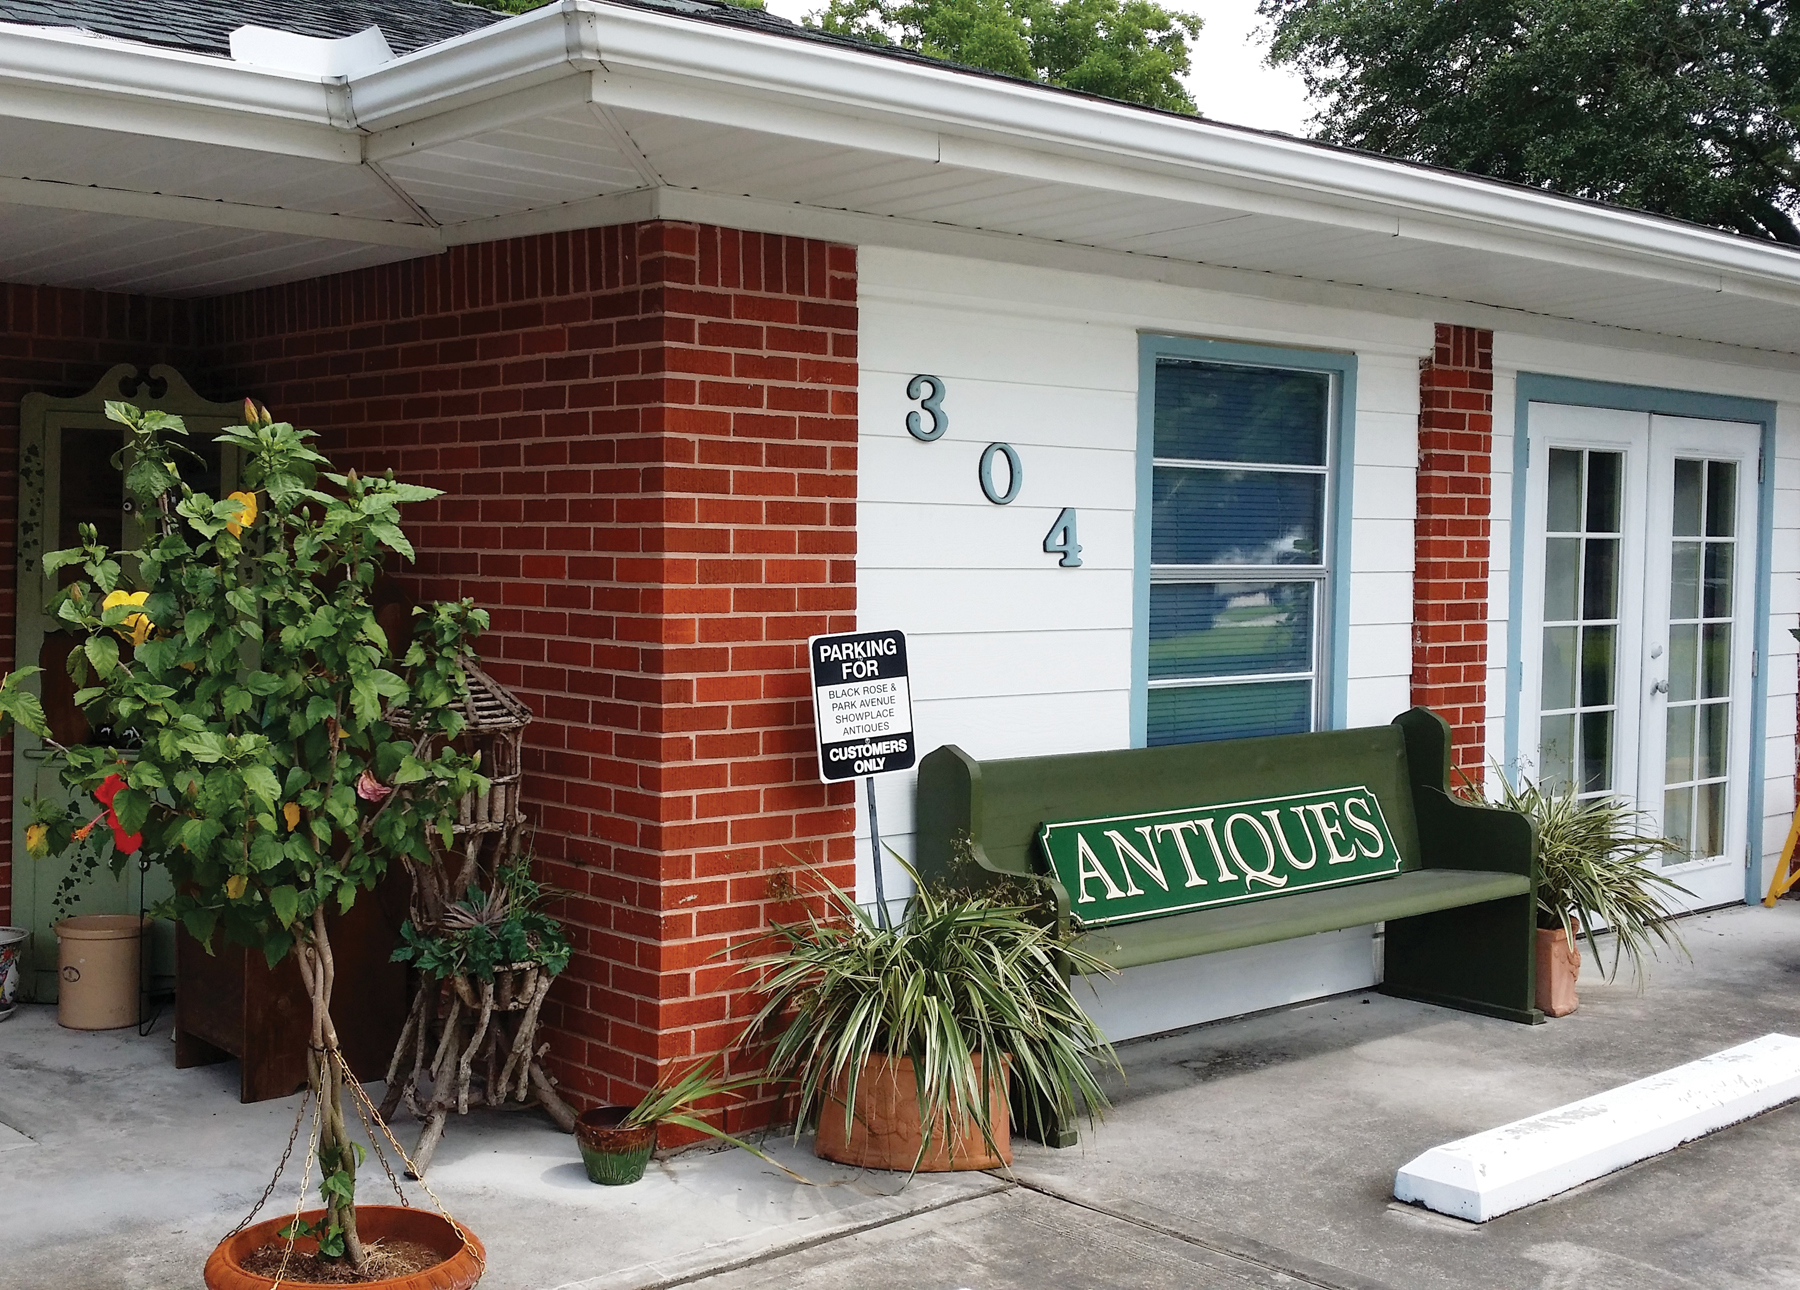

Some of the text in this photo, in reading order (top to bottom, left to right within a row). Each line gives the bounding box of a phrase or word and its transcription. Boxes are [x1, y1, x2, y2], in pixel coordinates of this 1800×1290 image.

[820, 638, 897, 662] PARKING
[842, 660, 879, 679] FOR
[829, 683, 897, 699] BLACK ROSE &
[832, 696, 896, 711] PARK AVENUE
[835, 709, 894, 724] SHOWPLACE
[843, 722, 889, 736] ANTIQUES
[829, 739, 907, 761] CUSTOMERS
[854, 757, 885, 773] ONLY
[1077, 797, 1384, 904] ANTIQUES
